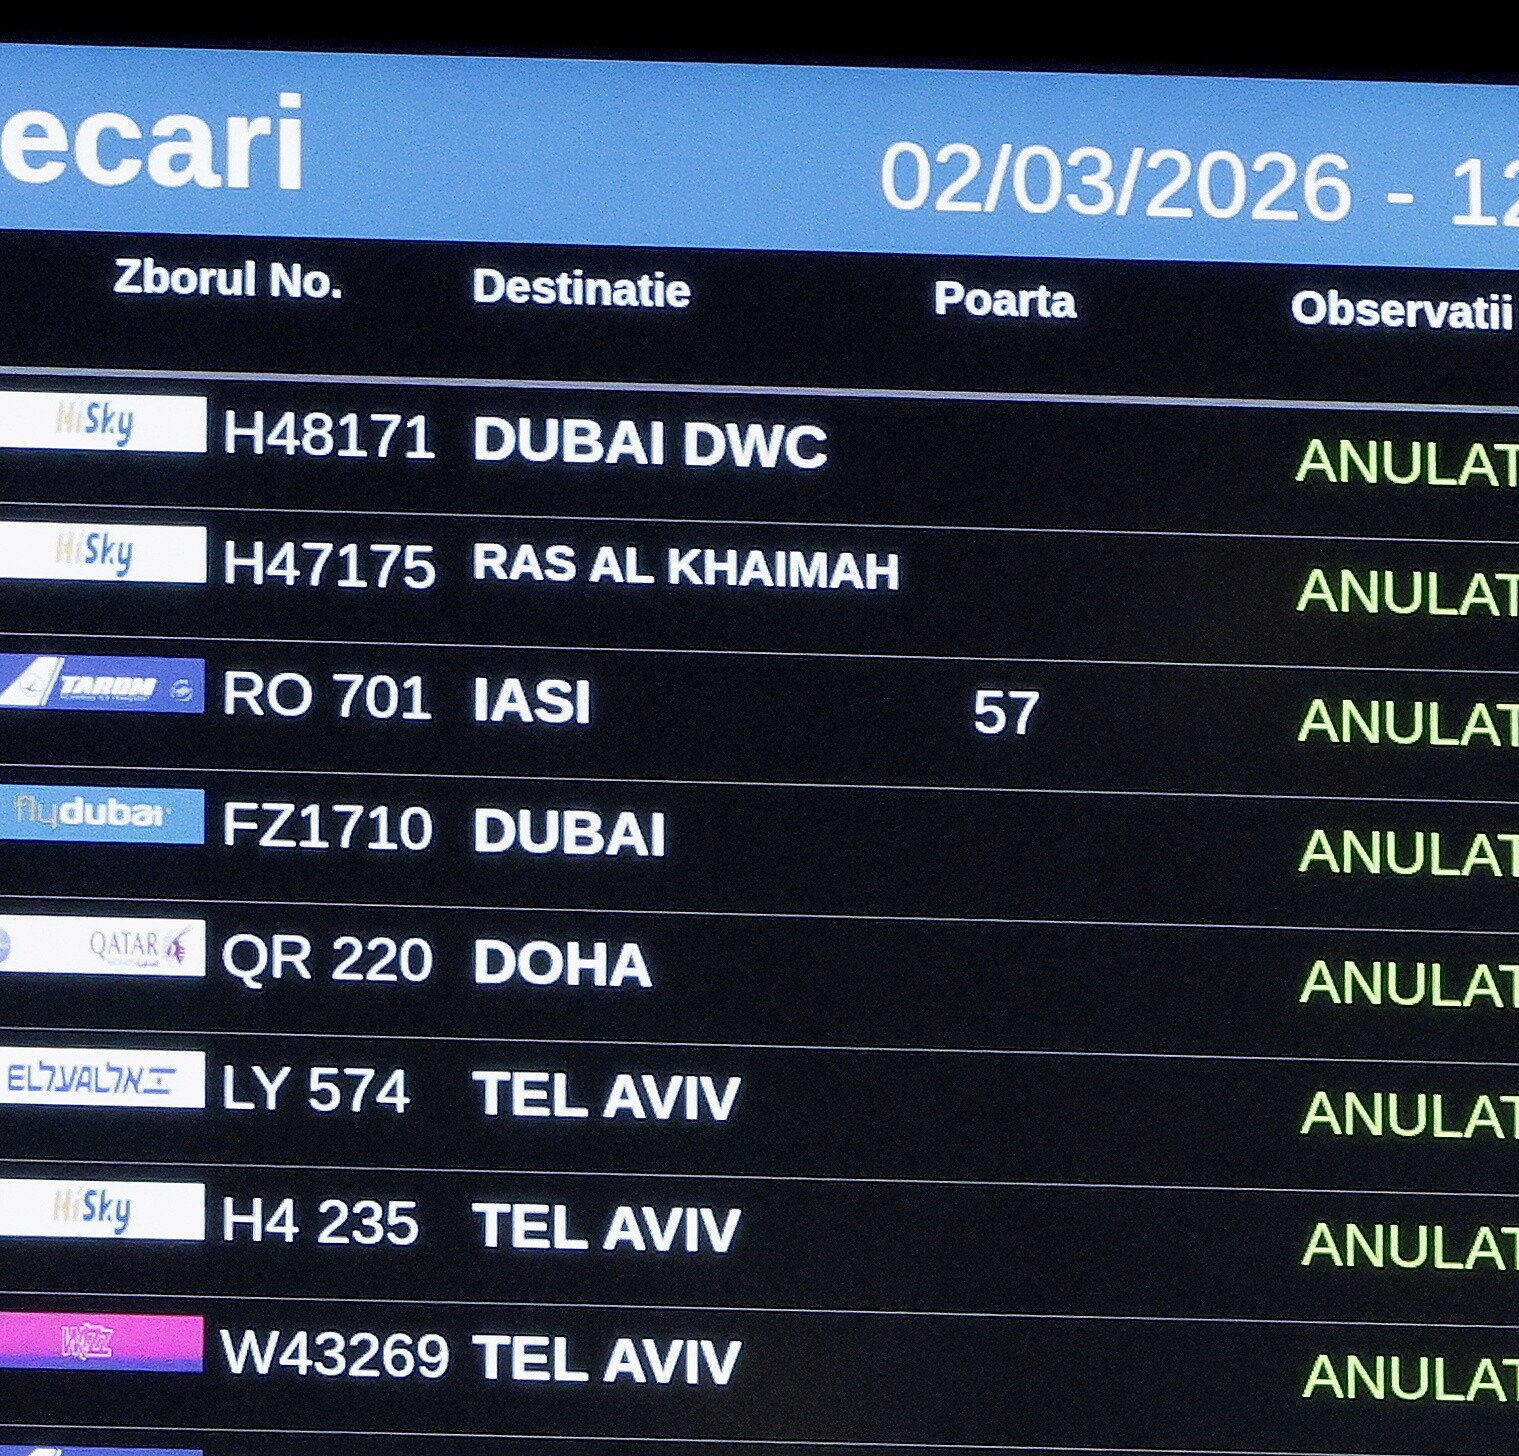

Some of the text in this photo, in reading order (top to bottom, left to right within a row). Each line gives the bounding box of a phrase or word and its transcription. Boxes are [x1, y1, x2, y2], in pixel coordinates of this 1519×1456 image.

[882, 141, 1351, 222] 02/03/2026
[113, 257, 342, 299] Zborul No.
[473, 268, 691, 308] Destinatie
[935, 280, 1078, 319] Poarta
[1291, 289, 1513, 331] Observatii
[224, 409, 436, 459] H48171
[474, 416, 828, 469] DUBAI DWC
[224, 540, 436, 589] H47175
[473, 542, 900, 590] RAS AL KHAIMAH
[59, 675, 158, 695] TAROM
[224, 670, 432, 720] RO 701
[474, 677, 590, 724] IASI
[974, 689, 1040, 735] 57
[224, 801, 433, 851] FZ1710
[474, 807, 665, 857] DUBAI
[90, 930, 158, 959] QATAR
[222, 933, 433, 990] QR 220
[474, 939, 653, 988] DOHA
[223, 1064, 411, 1114] LY 574
[471, 1070, 742, 1121] TEL AVIV
[223, 1196, 419, 1246] H4 235
[471, 1202, 742, 1253] TEL AVIV
[219, 1329, 450, 1379] W43269
[471, 1334, 743, 1385] TEL AVIV
